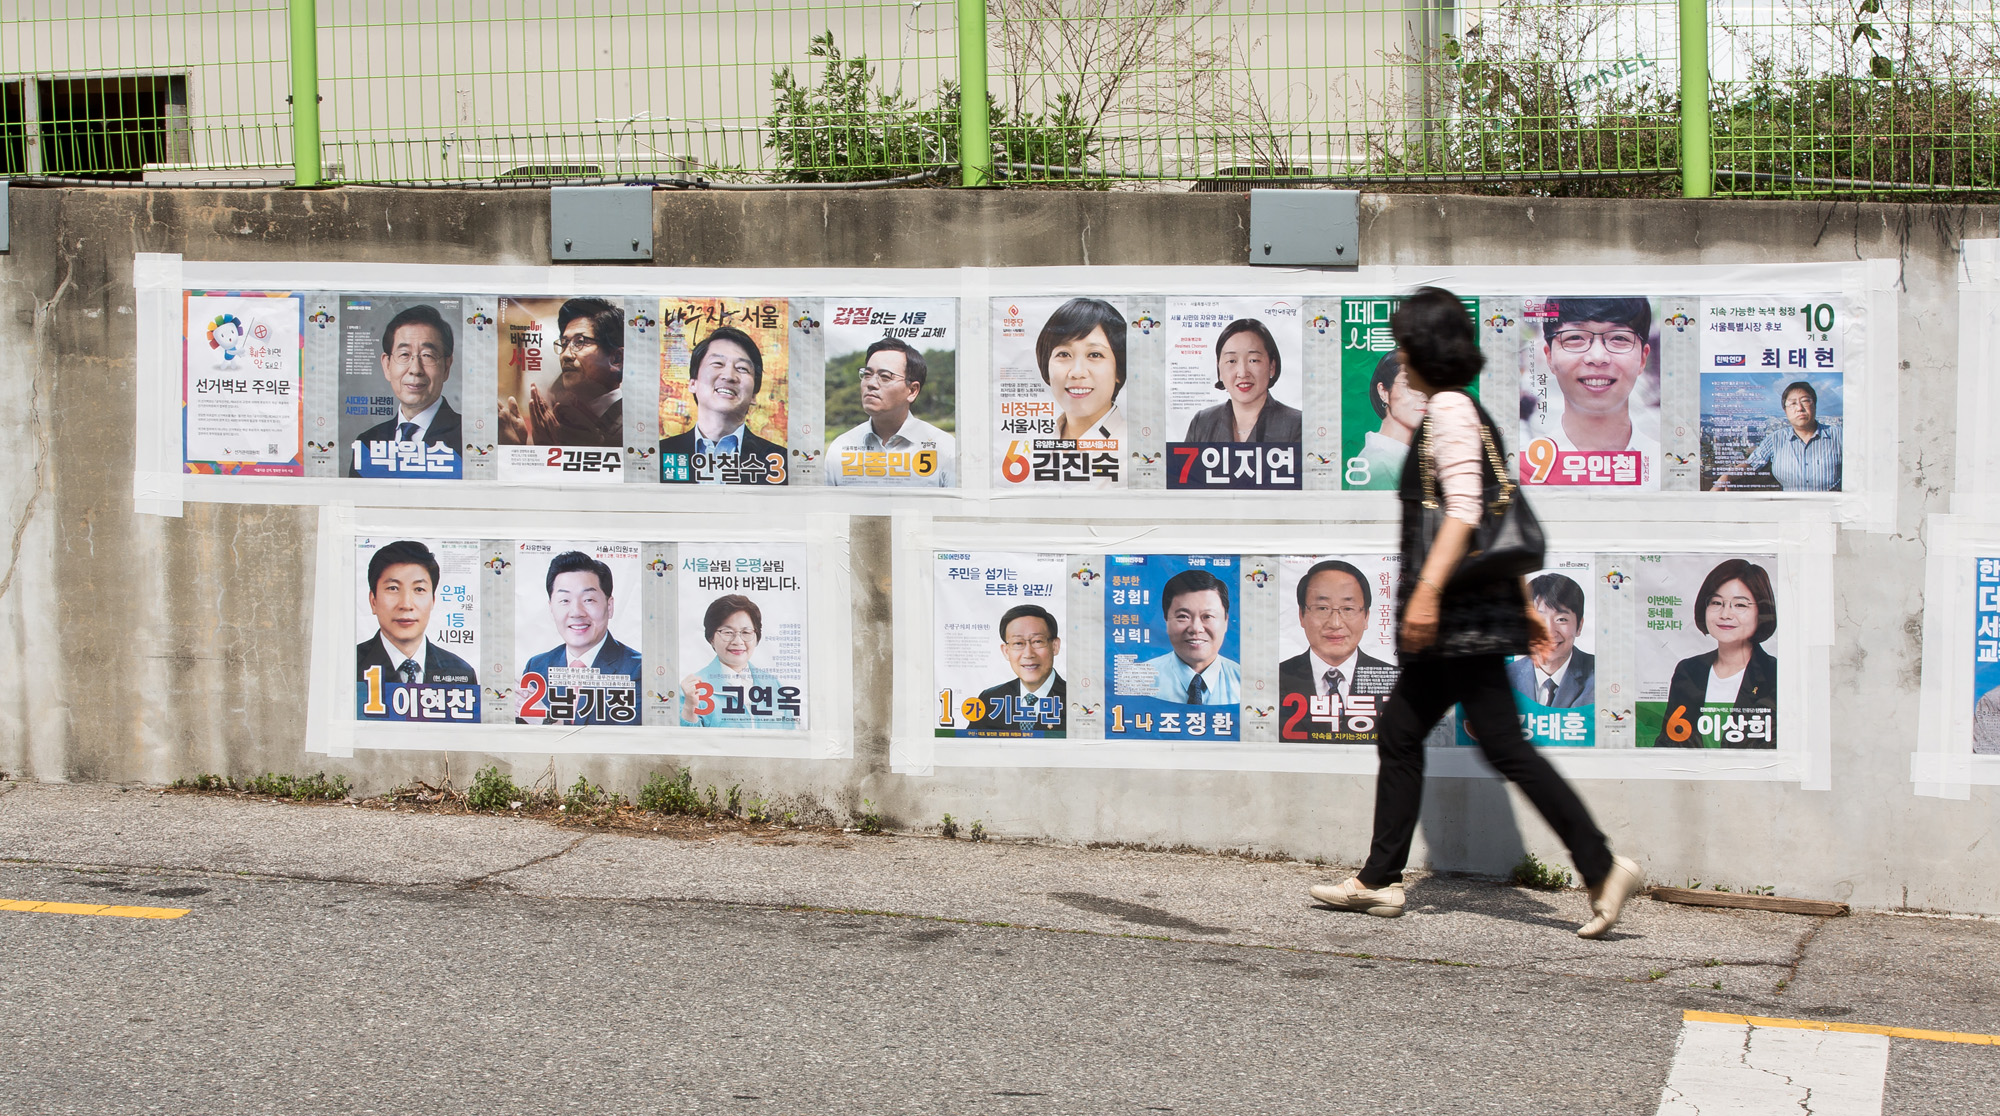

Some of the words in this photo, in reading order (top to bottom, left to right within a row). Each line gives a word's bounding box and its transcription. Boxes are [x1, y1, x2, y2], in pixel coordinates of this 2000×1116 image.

[1524, 299, 1559, 312] 우리미래
[1709, 306, 1727, 317] 지속
[1729, 306, 1755, 317] 가능한
[1757, 306, 1775, 317] 녹색
[1778, 306, 1796, 317] 청정
[900, 311, 927, 325] 서울
[1003, 318, 1024, 327] 민중당
[1800, 303, 1835, 333] 10
[882, 327, 919, 338] 제1야당
[921, 327, 946, 338] 교체!
[1709, 321, 1762, 332] 서울특별시장
[1765, 321, 1782, 332] 후보
[510, 332, 543, 348] 바꾸자
[249, 346, 281, 358] 훼손하면
[508, 347, 543, 371] 서울
[254, 359, 263, 369] 안
[1716, 355, 1743, 364] 친박연대
[196, 378, 248, 394] 선거벽보
[252, 379, 291, 395] 주의문
[345, 396, 369, 406] 시대와
[370, 396, 393, 406] 나란히
[345, 406, 369, 416] 시민과
[370, 406, 393, 416] 나란히
[1001, 402, 1054, 417] 비정규직
[1001, 418, 1055, 434] 서울시장
[920, 441, 936, 449] 정의당
[1035, 440, 1055, 449] 유일한
[1055, 440, 1076, 449] 노동자
[1078, 440, 1117, 449] 진보서울시장
[352, 440, 363, 471] 1
[370, 440, 454, 472] 박원순
[547, 447, 562, 467] 2
[563, 451, 621, 473] 김문수
[664, 454, 688, 467] 서울
[1002, 440, 1030, 483] 6
[1033, 452, 1119, 482] 김진숙
[1527, 438, 1555, 482] 9
[1562, 454, 1637, 483] 우인철
[691, 452, 766, 482] 안철수
[766, 453, 785, 483] 3
[841, 450, 911, 477] 김종민
[919, 453, 932, 473] 5
[1173, 447, 1199, 484] 7
[1201, 446, 1295, 485] 인지연
[664, 467, 689, 480] 살림
[1345, 457, 1371, 486] 8
[937, 553, 971, 561] 더불어민주당
[1640, 555, 1661, 563] 녹색당
[683, 557, 731, 573] 서울살림
[735, 558, 784, 573] 은평살림
[1559, 560, 1589, 571] 바른미래당
[948, 567, 981, 581] 주민을
[985, 567, 1018, 581] 섬기는
[1112, 575, 1140, 586] 풍부한
[699, 576, 739, 591] 바꿔야
[743, 576, 801, 591] 바뀝니다.
[984, 583, 1018, 596] 든든한
[1022, 583, 1053, 597] 일꾼!!
[1378, 571, 1391, 599] 함께
[460, 603, 474, 611] 키운
[1647, 595, 1682, 606] 이번에는
[1112, 614, 1140, 625] 검증된
[1647, 607, 1673, 618] 동네를
[446, 612, 465, 628] 1등
[944, 623, 971, 631] 은평구의회
[1378, 604, 1392, 645] 꿈꾸는
[1647, 620, 1682, 631] 바꿉시다
[437, 629, 474, 644] 시의원
[364, 665, 387, 715] 1
[392, 686, 476, 720] 이현찬
[520, 673, 547, 718] 2
[548, 687, 636, 722] 남기정
[694, 682, 716, 716] 3
[721, 685, 801, 716] 고연옥
[939, 687, 954, 727] 1
[964, 701, 982, 718] 가
[989, 694, 1063, 725] 기노만
[1282, 692, 1308, 740] 2
[1309, 695, 1388, 733] 박등
[1158, 711, 1234, 736] 조정환
[1666, 705, 1692, 742] 6
[1697, 714, 1772, 743] 이상희
[1311, 732, 1332, 740] 약속을
[1334, 732, 1370, 741] 지키는것이
